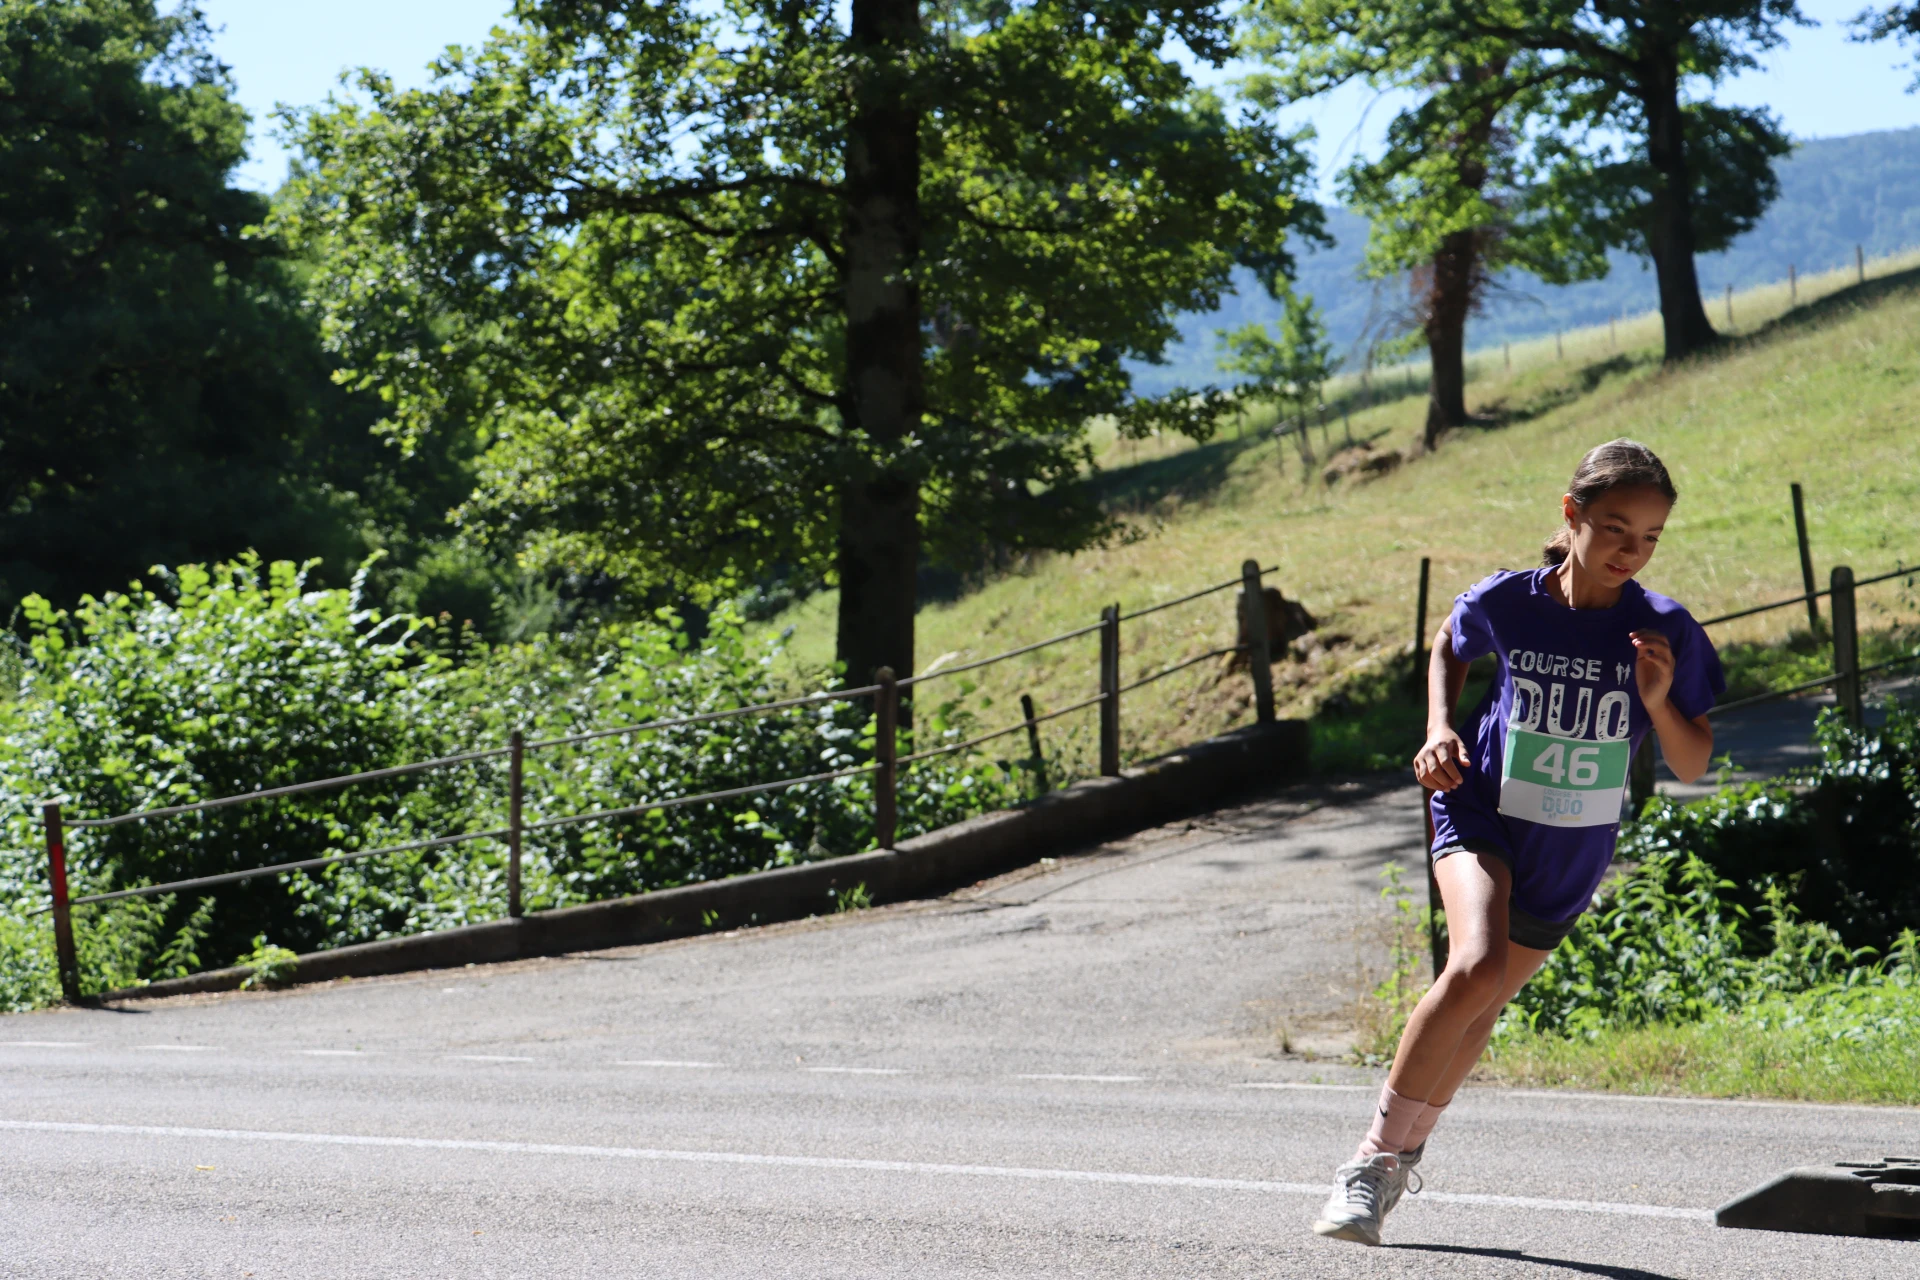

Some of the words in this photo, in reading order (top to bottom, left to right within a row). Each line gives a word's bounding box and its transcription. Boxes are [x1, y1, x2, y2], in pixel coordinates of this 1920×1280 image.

[1508, 649, 1602, 682] COURSE
[1509, 676, 1631, 740] DUO
[1533, 742, 1600, 786] 46
[1542, 796, 1583, 816] DUO
